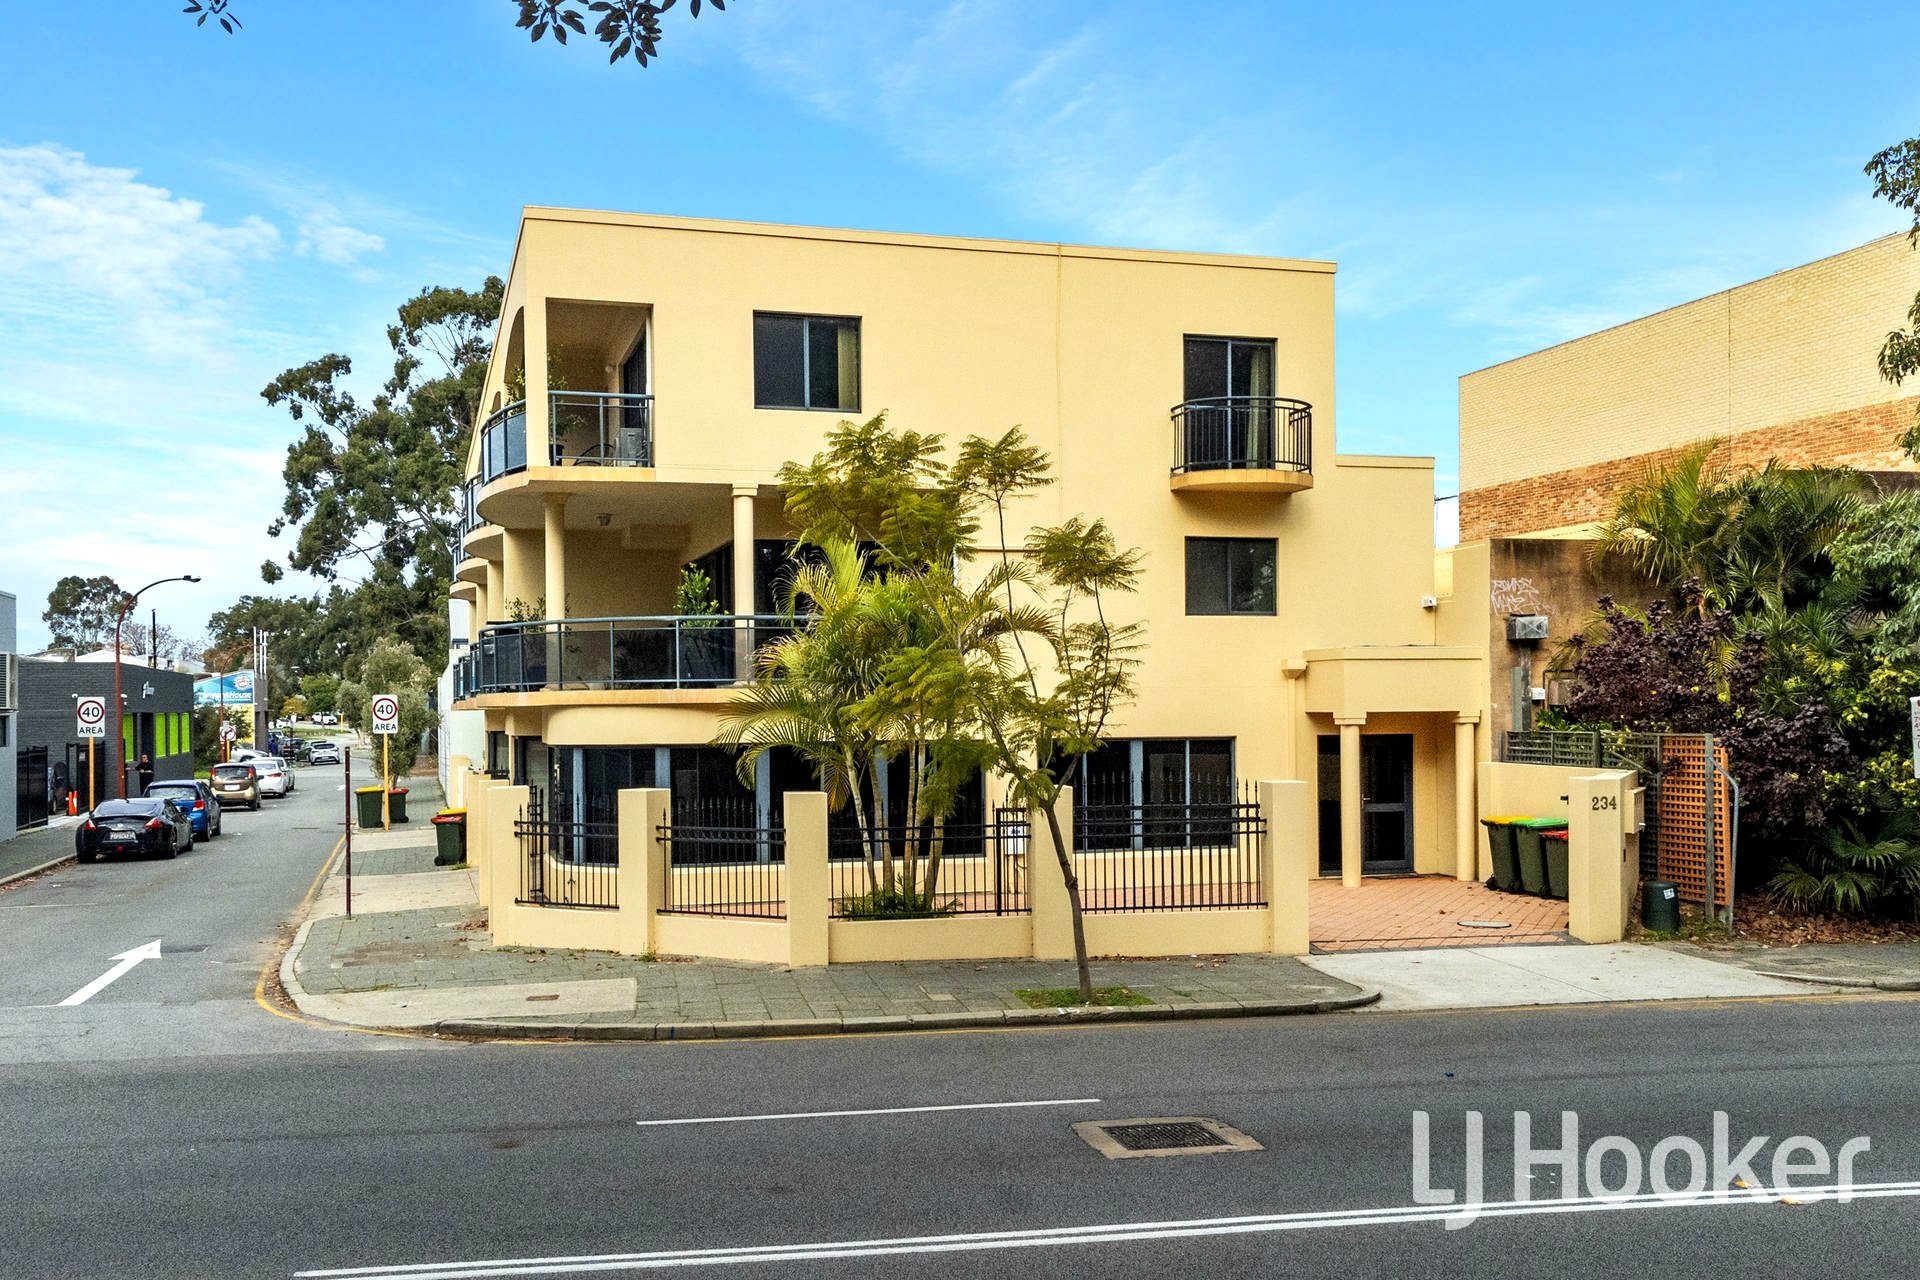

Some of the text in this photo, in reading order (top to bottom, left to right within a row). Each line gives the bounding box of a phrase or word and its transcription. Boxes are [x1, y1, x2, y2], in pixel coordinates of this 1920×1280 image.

[82, 706, 100, 718] 40
[377, 704, 394, 715] 40
[79, 726, 104, 734] AREA
[374, 723, 397, 731] AREA
[1591, 795, 1617, 811] 234
